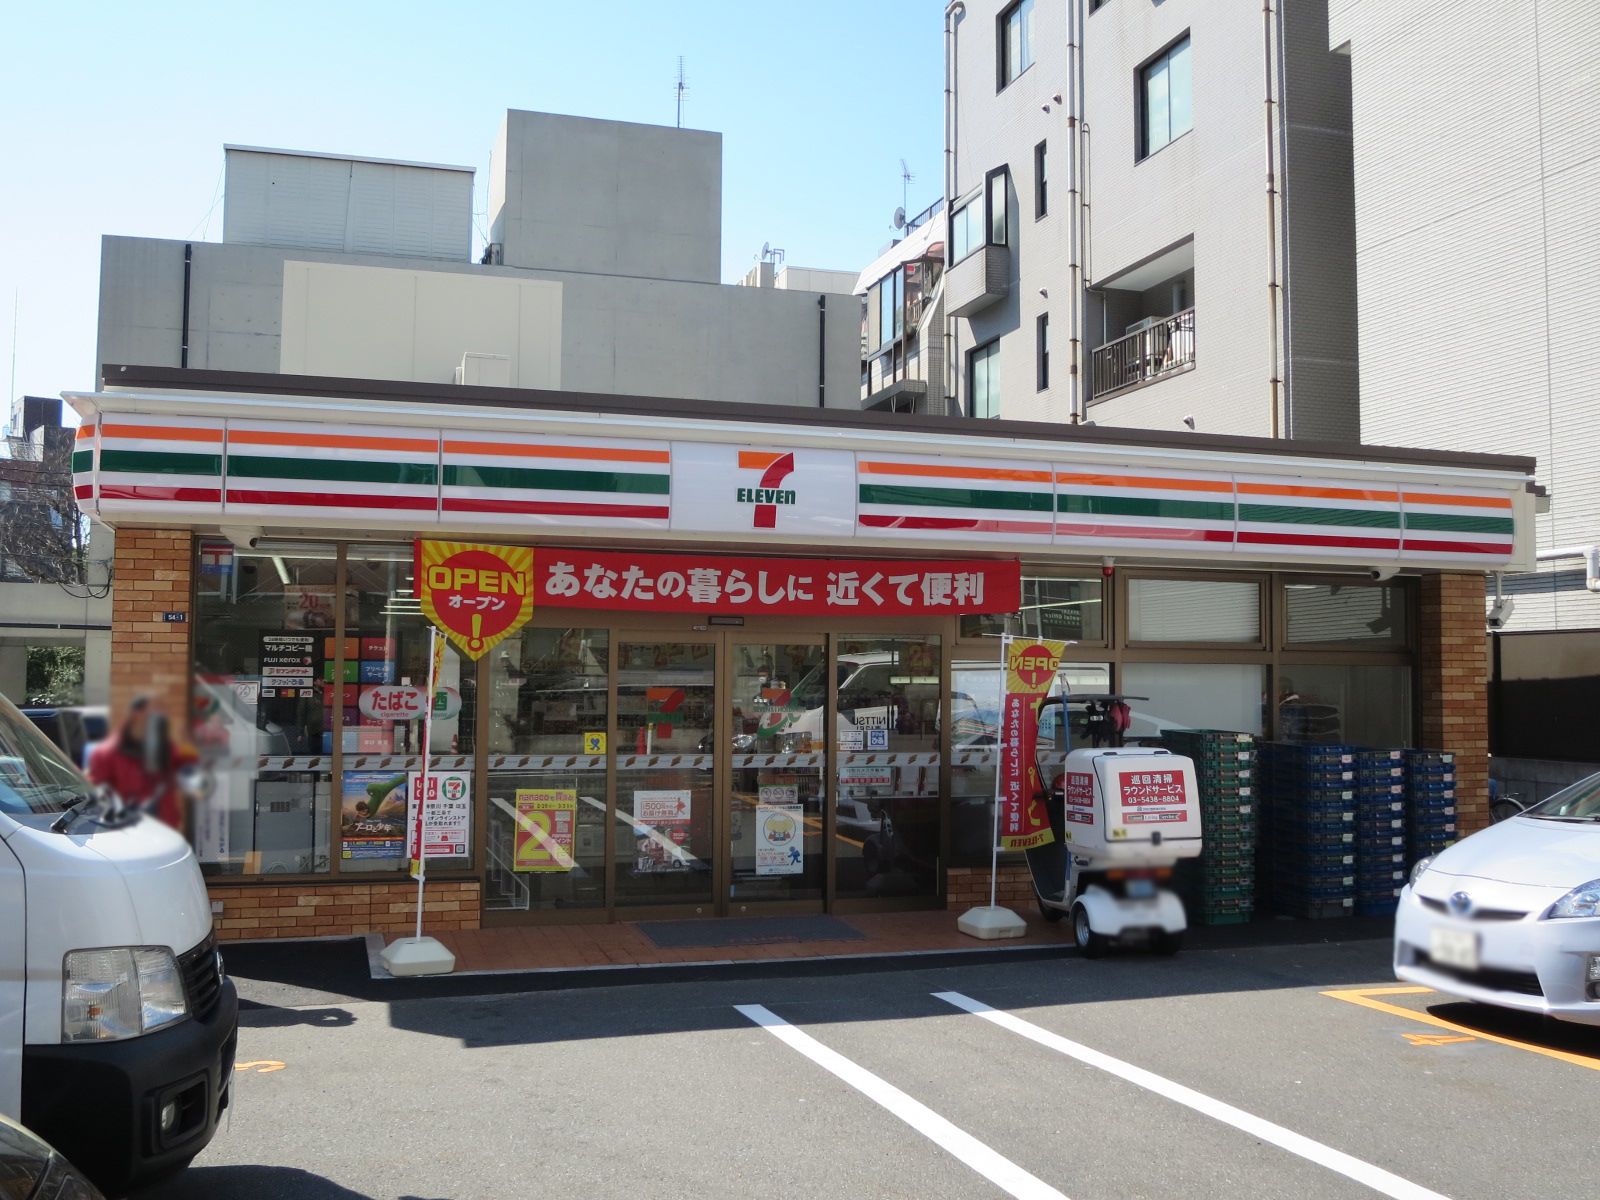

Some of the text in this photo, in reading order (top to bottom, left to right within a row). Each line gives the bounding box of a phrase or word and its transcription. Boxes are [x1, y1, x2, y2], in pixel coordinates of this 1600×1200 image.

[738, 450, 795, 529] 7
[428, 565, 526, 596] OPEN
[545, 561, 985, 607] あなたの暮らしに 近くて便利
[448, 594, 506, 611] オープン
[371, 690, 418, 711] たばこ
[1123, 784, 1183, 796] ラウンドサービス
[1131, 774, 1173, 785] 巡回清掃
